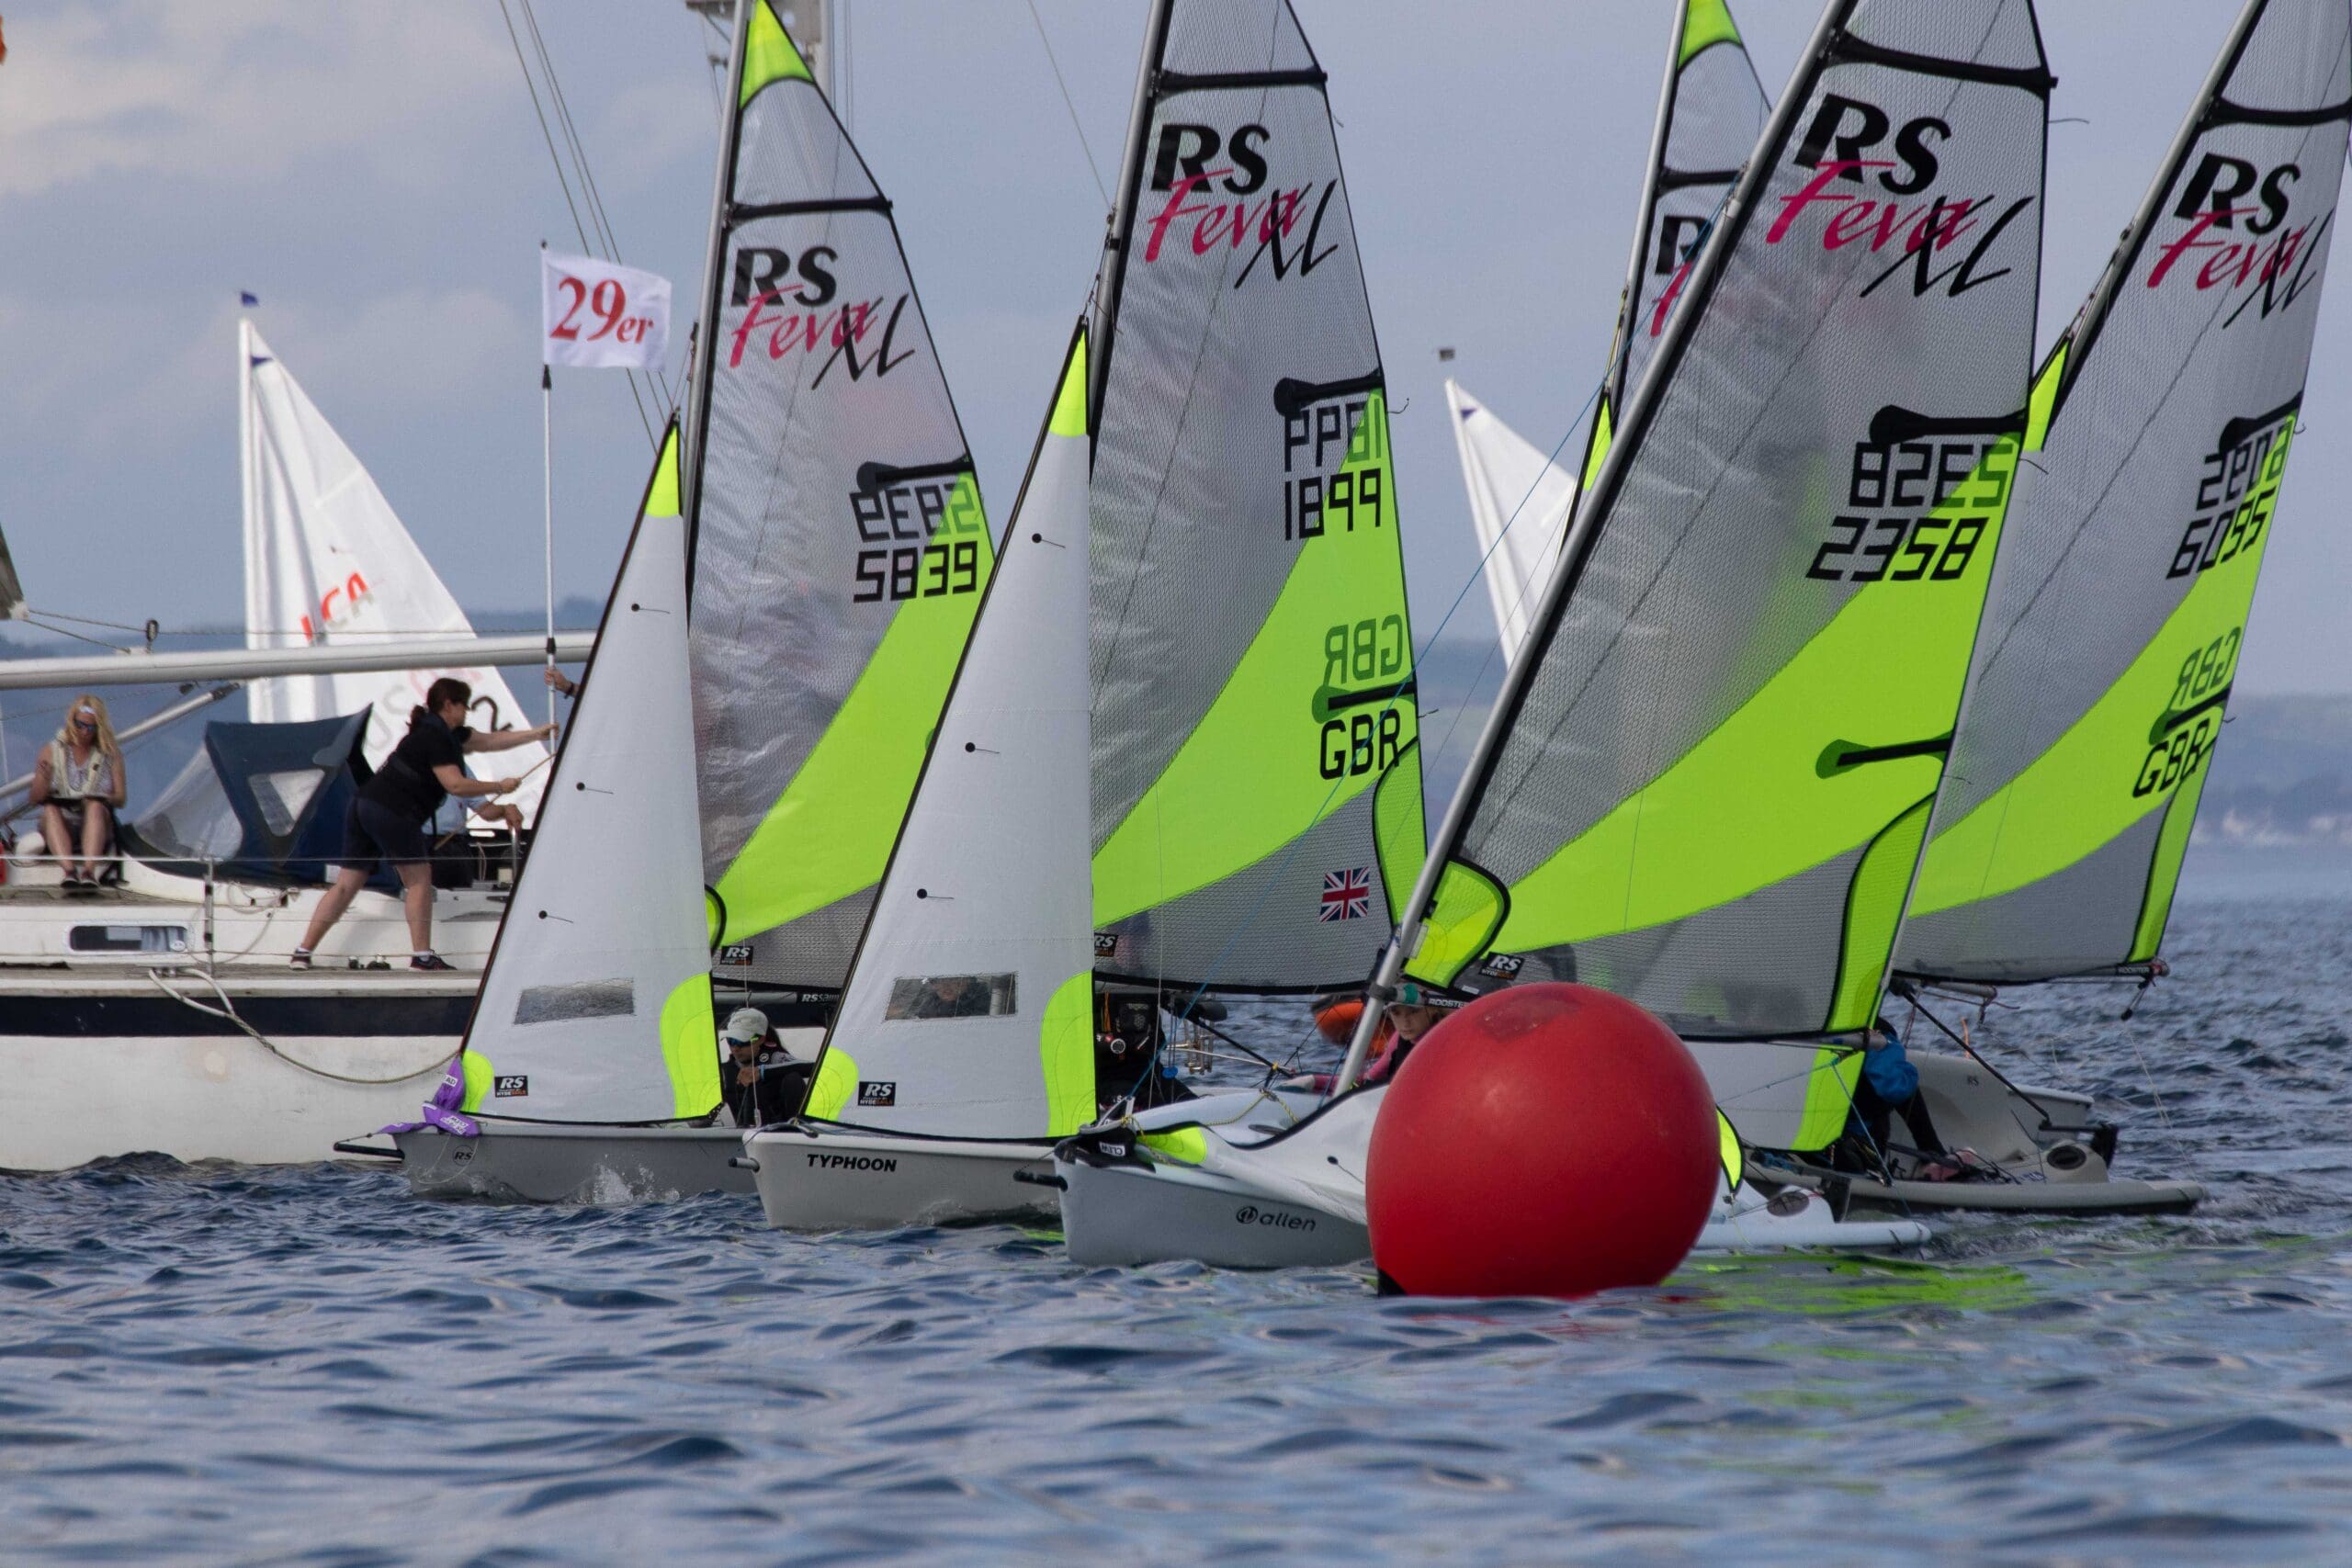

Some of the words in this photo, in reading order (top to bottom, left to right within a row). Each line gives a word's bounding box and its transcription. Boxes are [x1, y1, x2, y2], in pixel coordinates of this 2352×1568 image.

[1150, 124, 1271, 195] RS
[1794, 93, 1951, 195] RS
[1146, 168, 1308, 263] Feva
[1235, 178, 1338, 288] XL
[1766, 161, 1978, 253] Feva
[2174, 152, 2301, 235] RS
[731, 246, 838, 307] RS
[1860, 195, 2035, 299] XL
[2147, 208, 2306, 290] Feva
[2222, 207, 2335, 329] XL
[549, 276, 654, 344] 29er
[729, 284, 878, 367] Feva
[811, 294, 915, 390] XL
[1285, 468, 1382, 540] 1899
[2166, 485, 2277, 581] 6095
[853, 541, 978, 603] 5839
[1805, 516, 1989, 581] 2358
[1319, 708, 1400, 780] GBR
[2132, 717, 2211, 797] GBR
[726, 947, 750, 957] RS
[1489, 954, 1521, 972] RS
[1428, 998, 1465, 1009] ROOSTE
[500, 1077, 525, 1089] RS
[865, 1083, 893, 1097] RS
[454, 1151, 473, 1160] RS
[807, 1154, 897, 1172] TYPHOON
[1260, 1213, 1316, 1232] allen
